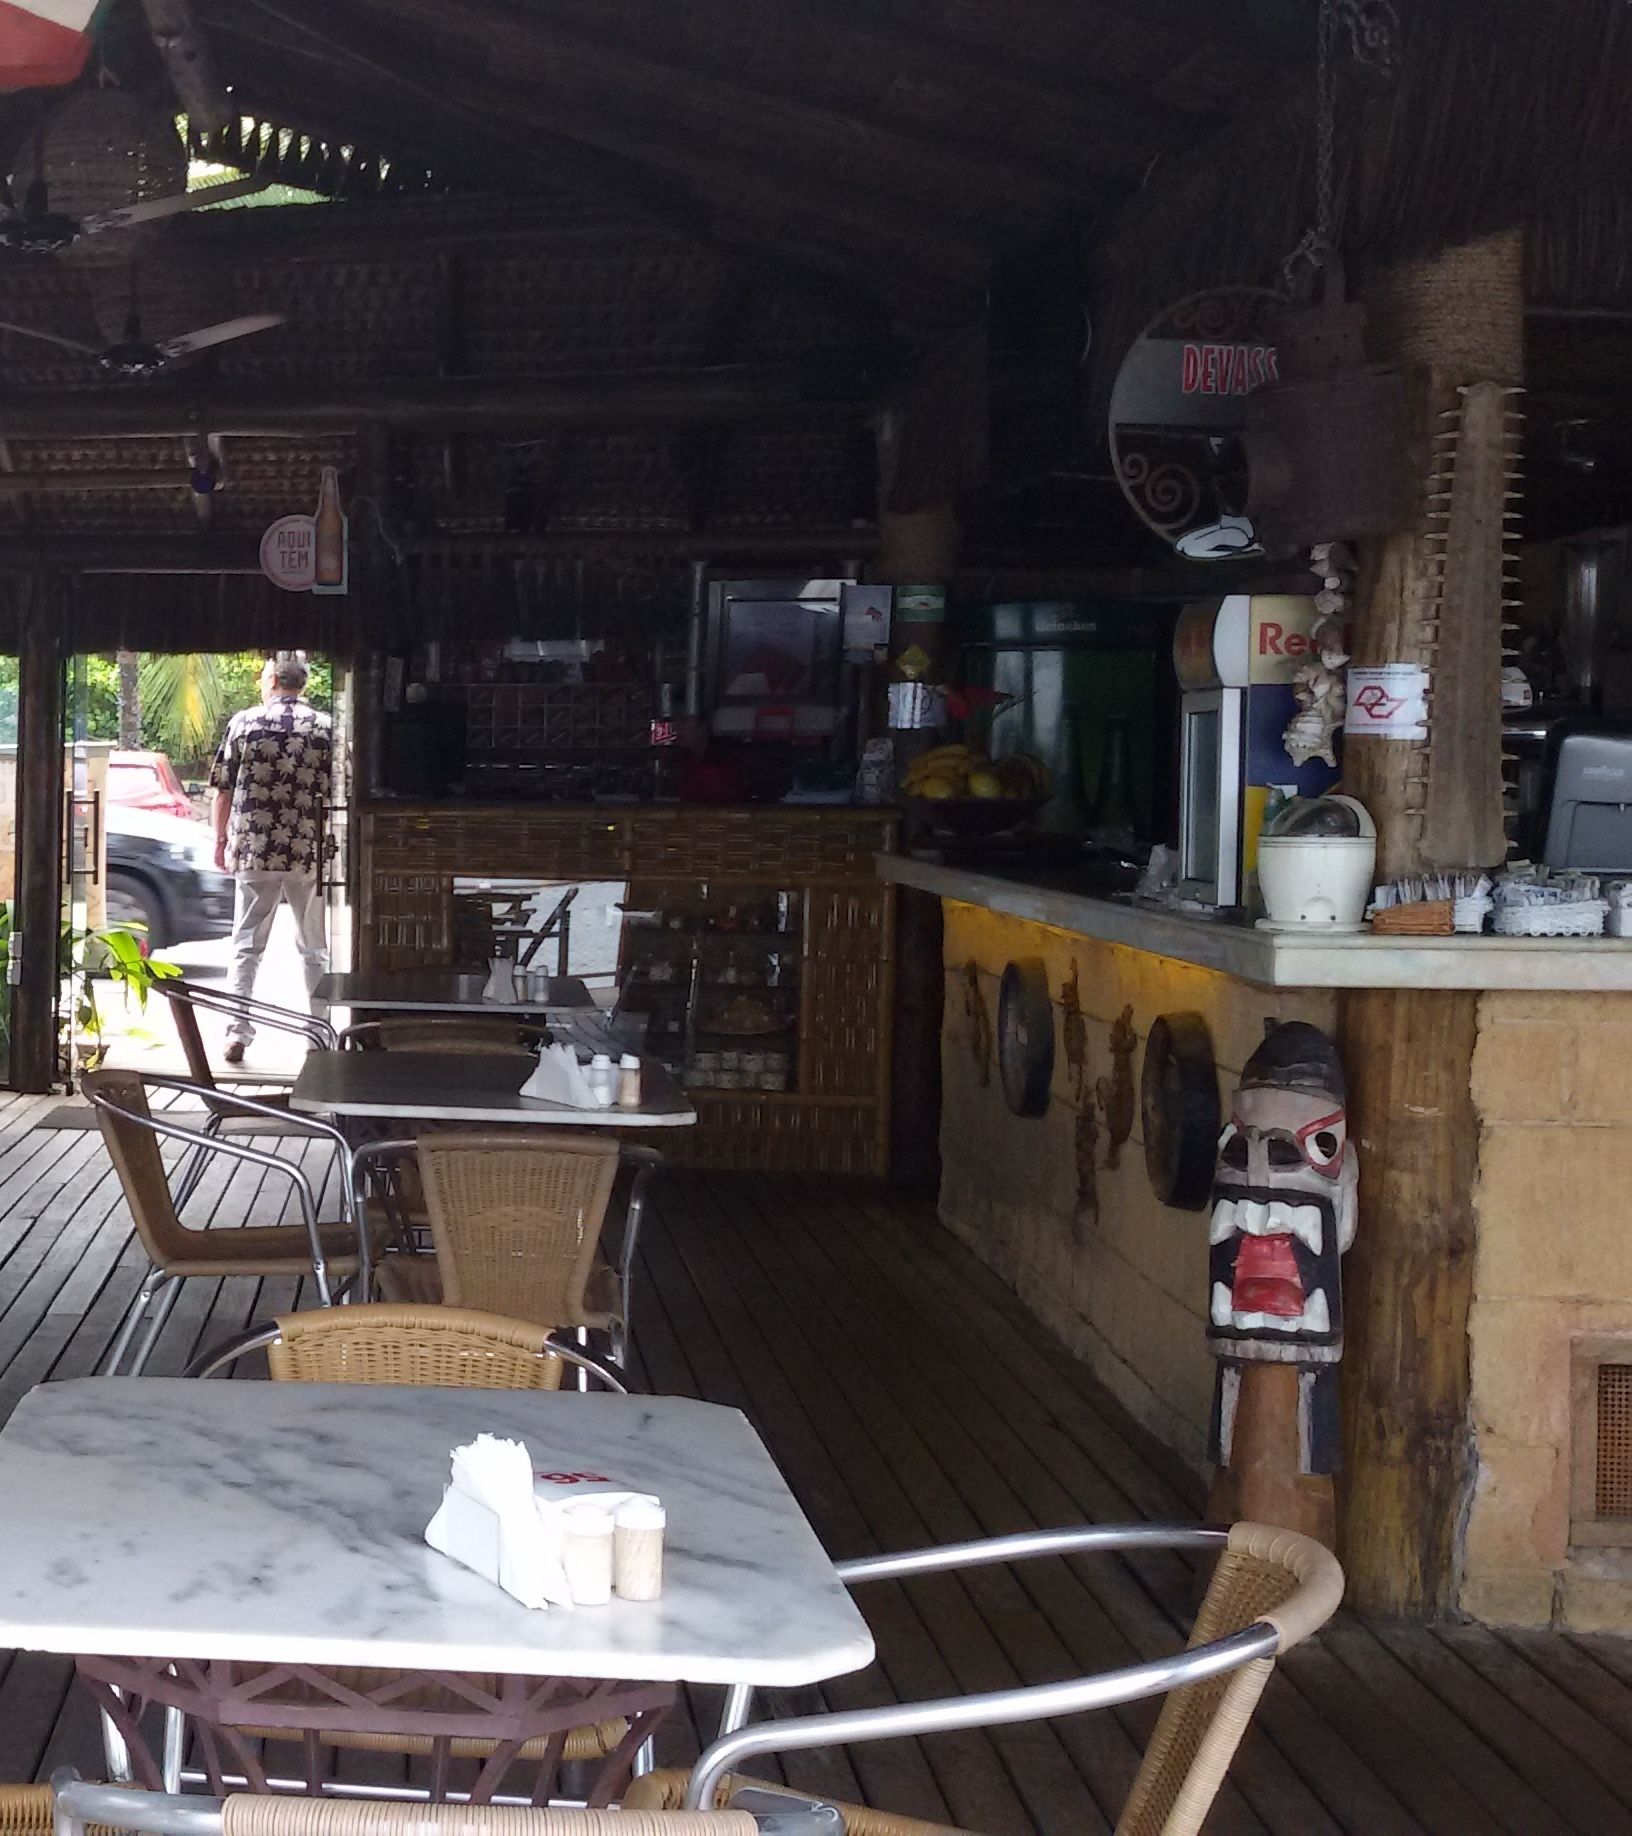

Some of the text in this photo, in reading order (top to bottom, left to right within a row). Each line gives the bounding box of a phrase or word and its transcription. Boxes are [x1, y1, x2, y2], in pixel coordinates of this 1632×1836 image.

[278, 531, 310, 548] AQUI
[280, 551, 308, 568] TEM
[1259, 622, 1319, 656] Re
